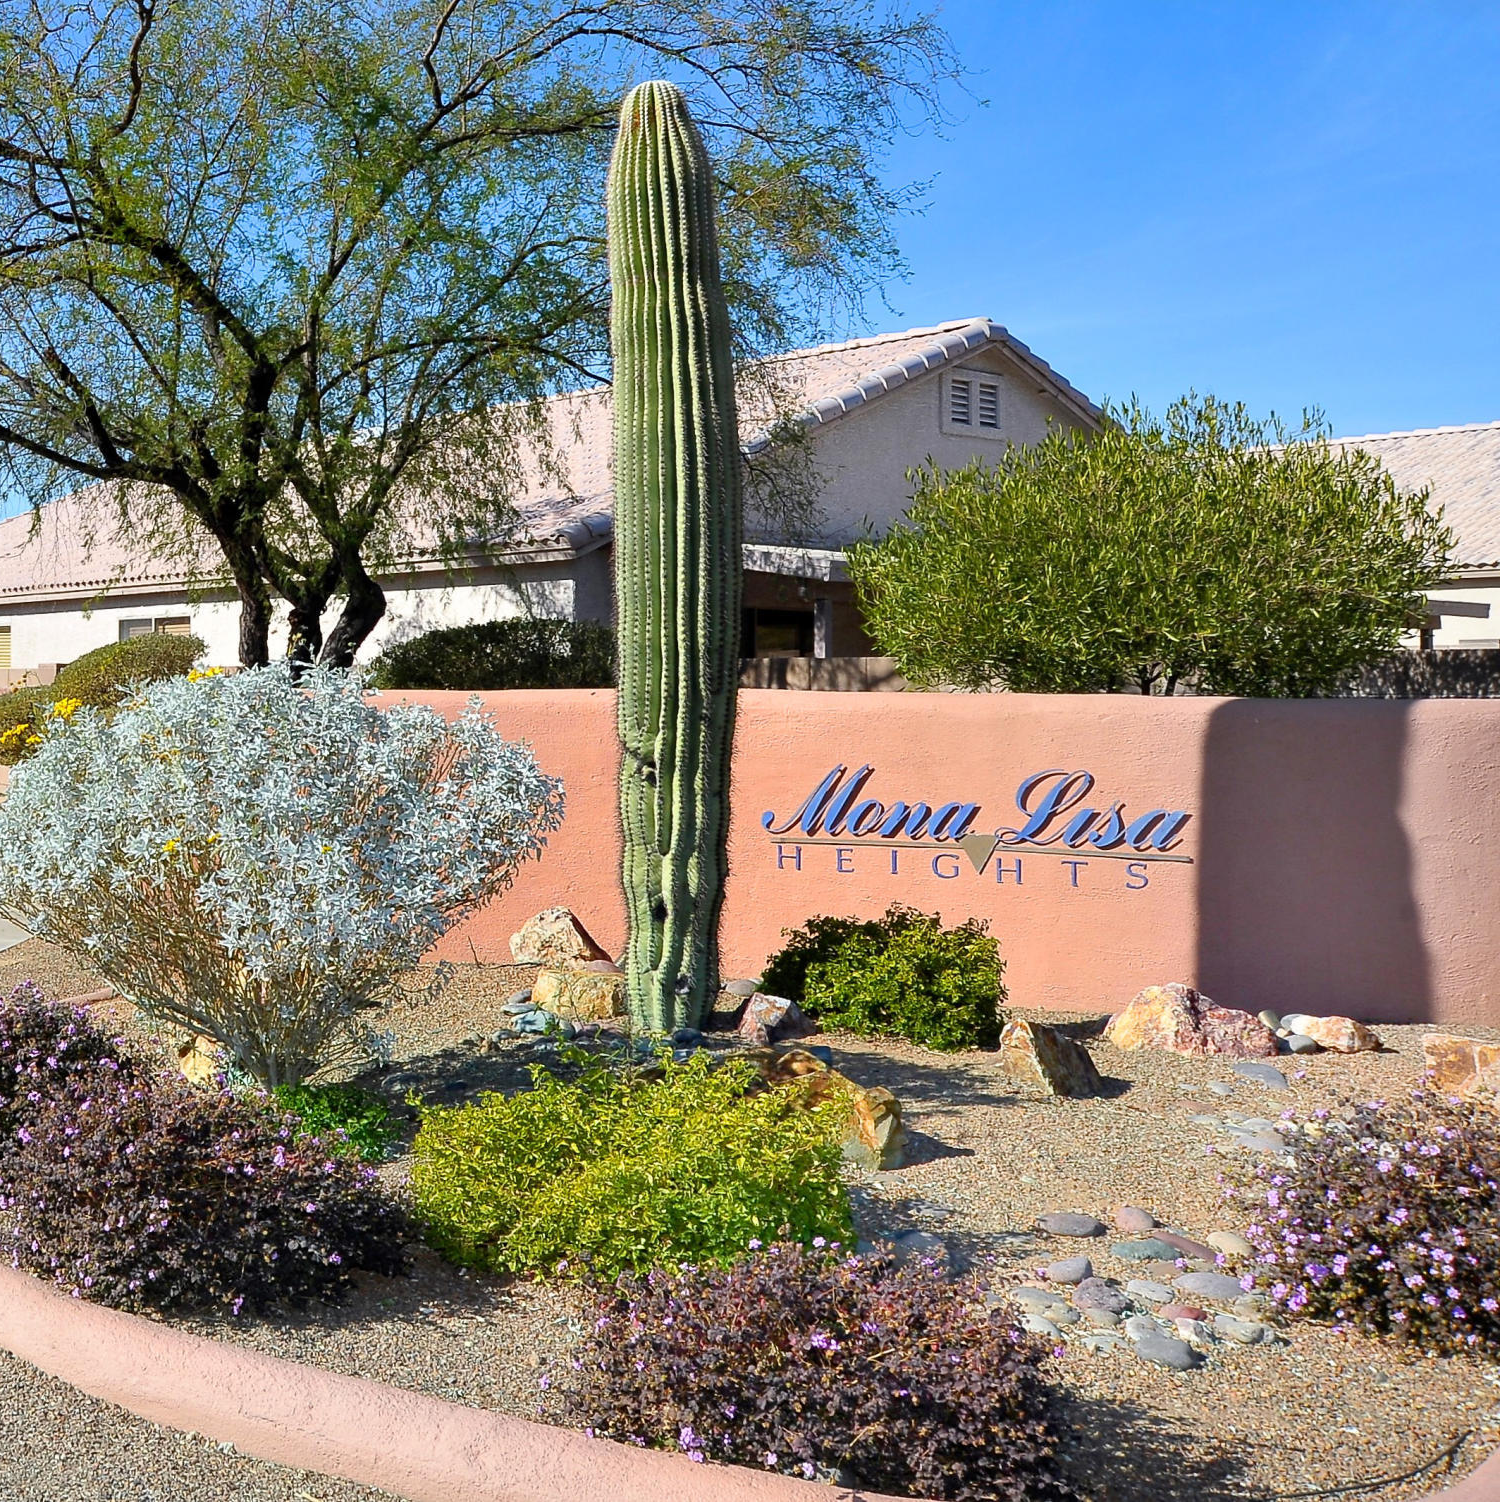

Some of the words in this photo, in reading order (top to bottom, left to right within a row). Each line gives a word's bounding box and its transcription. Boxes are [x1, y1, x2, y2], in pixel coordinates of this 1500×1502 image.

[761, 763, 980, 842] Mona
[994, 768, 1191, 852] Lisa
[776, 844, 1150, 890] HEIGHTS
